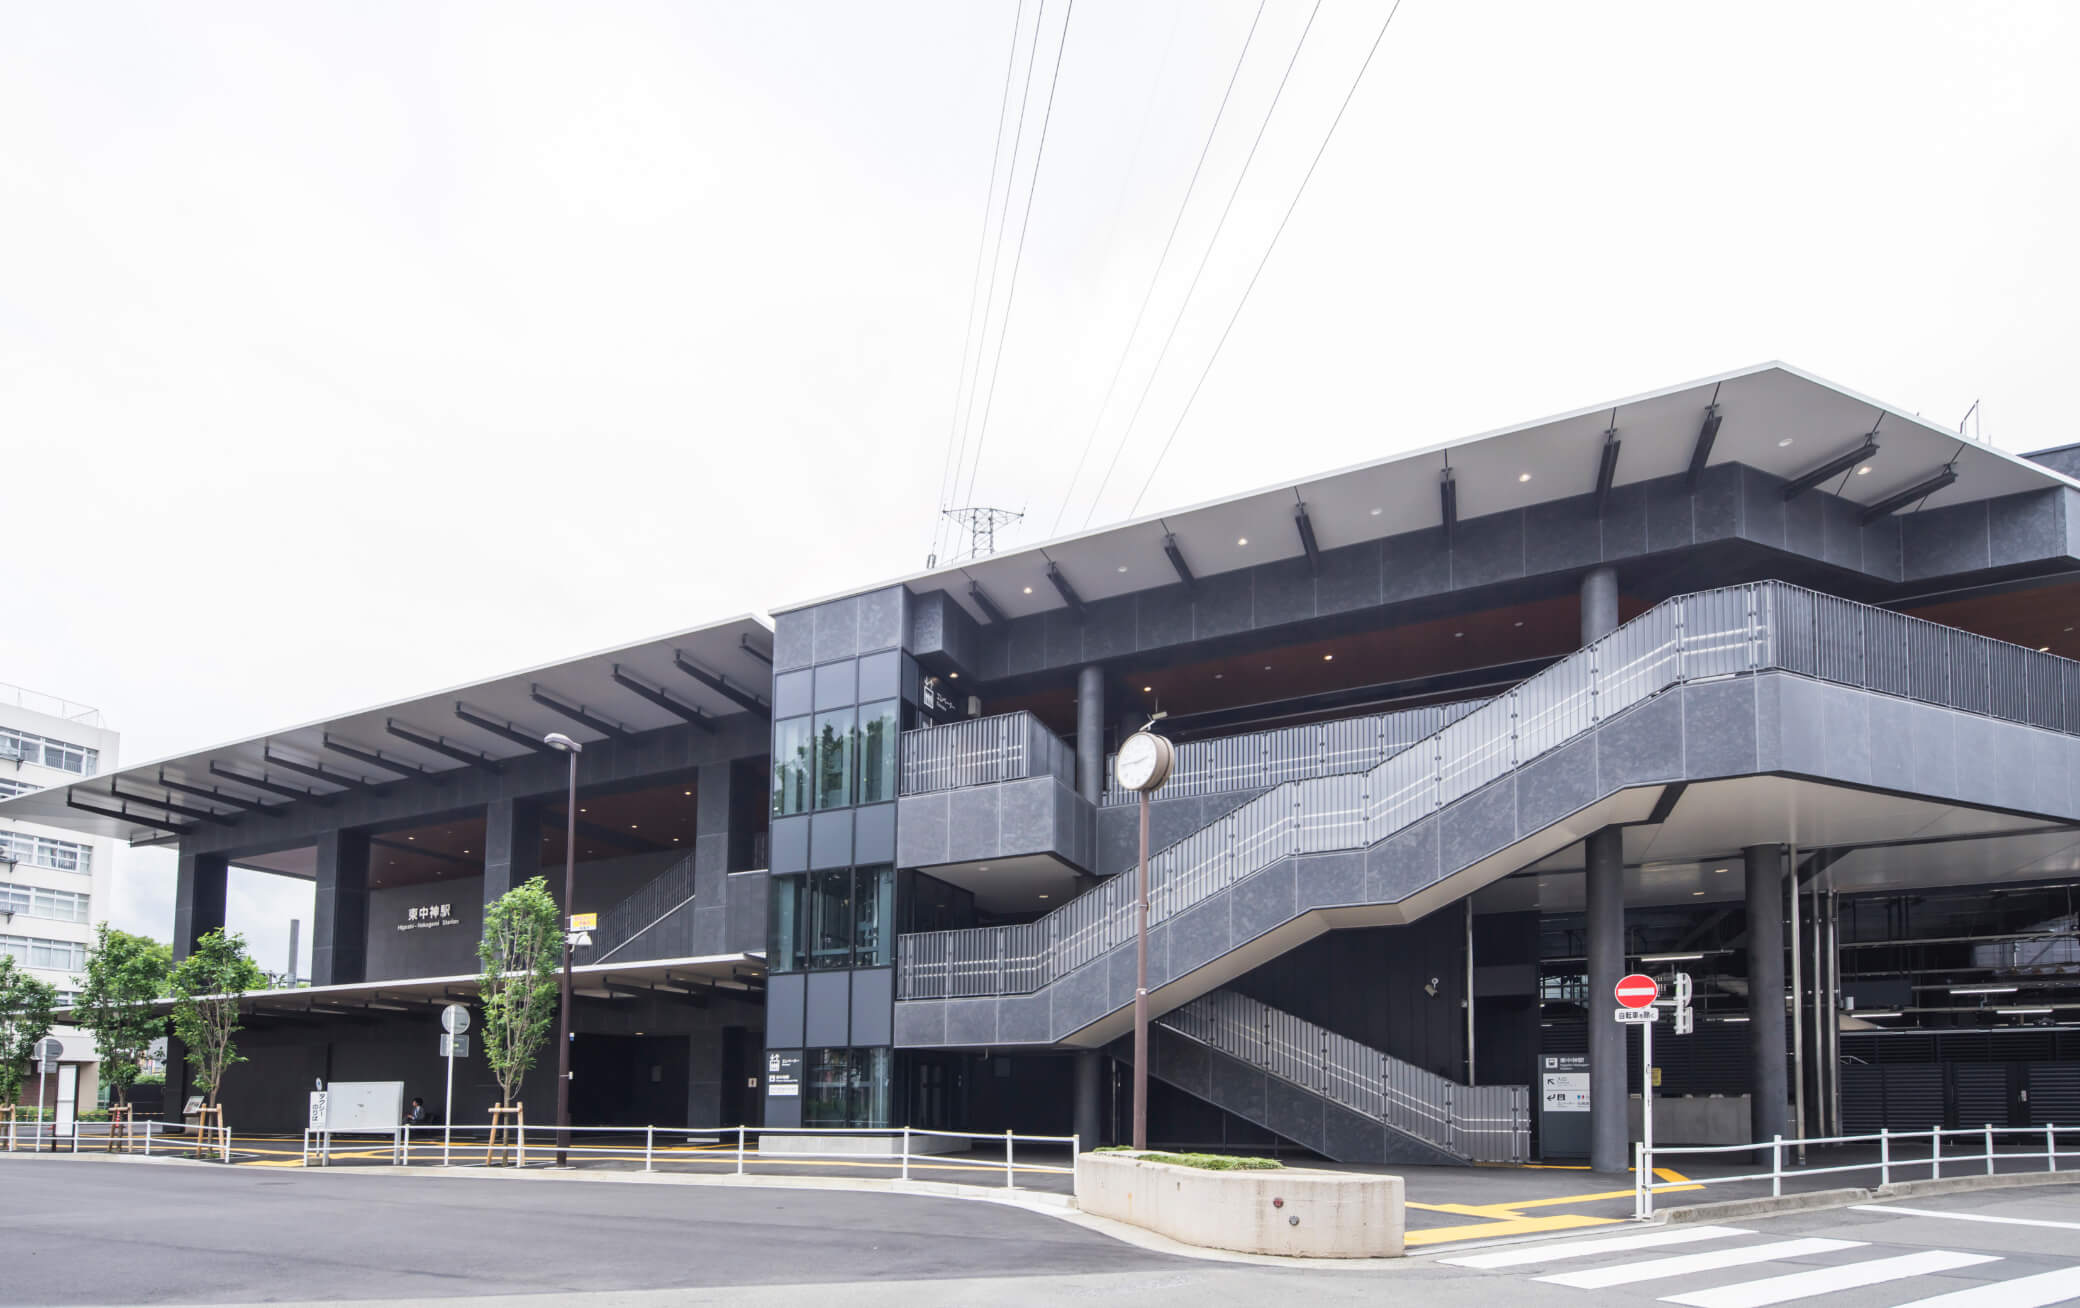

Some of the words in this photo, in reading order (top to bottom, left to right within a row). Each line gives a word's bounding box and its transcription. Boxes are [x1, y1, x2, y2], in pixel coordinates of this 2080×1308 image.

[408, 903, 451, 921] 東中神駅
[1618, 1011, 1655, 1020] 自転車を除く
